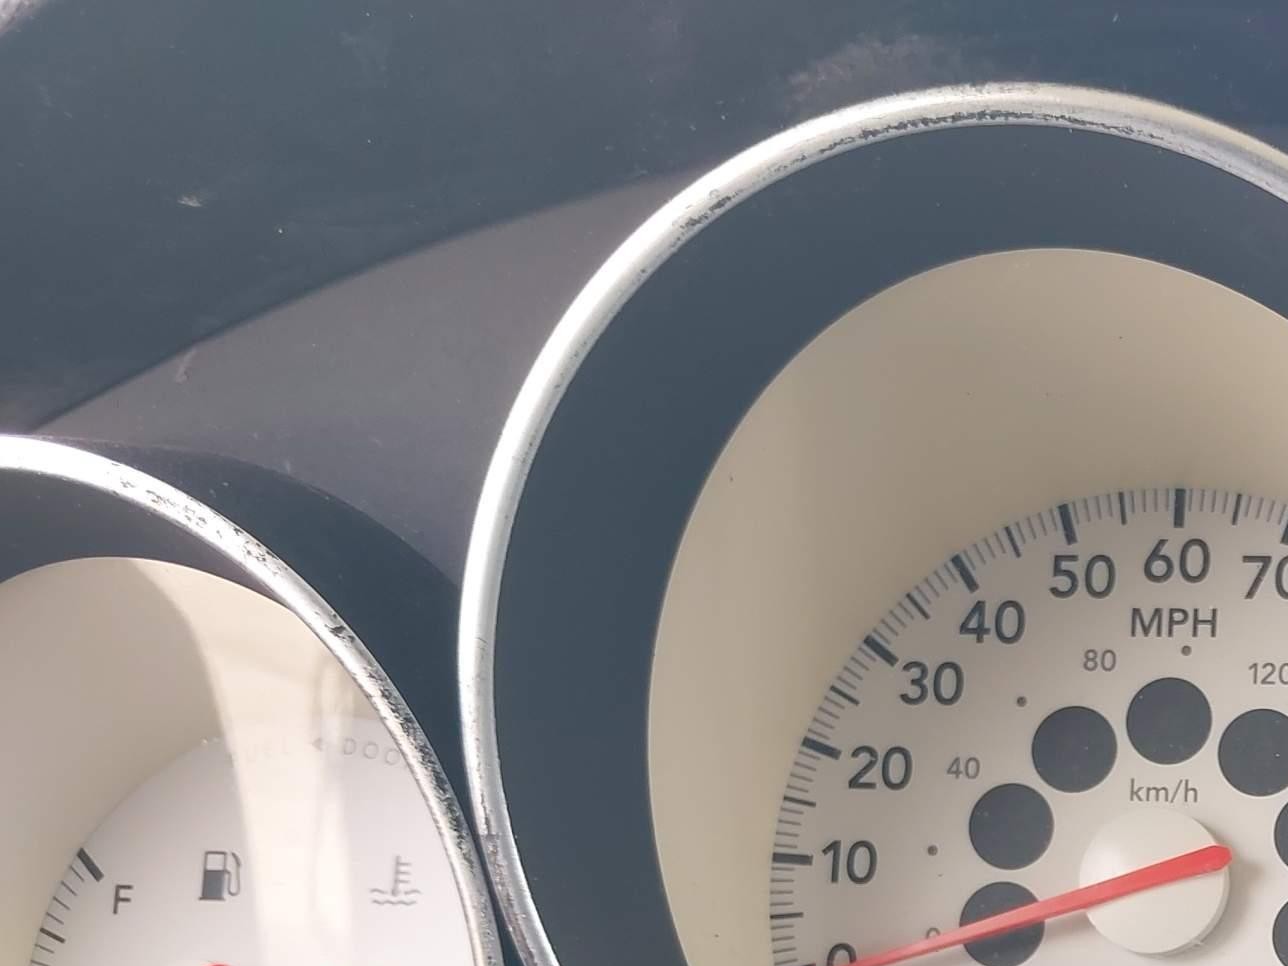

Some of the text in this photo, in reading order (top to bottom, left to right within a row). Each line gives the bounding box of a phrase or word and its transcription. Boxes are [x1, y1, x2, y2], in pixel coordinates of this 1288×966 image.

[1050, 555, 1115, 598] 50
[1144, 539, 1209, 583] 60
[960, 600, 1024, 644] 40
[1131, 608, 1216, 637] MPH
[1083, 649, 1116, 671] 80
[900, 661, 963, 705] 30
[342, 736, 408, 768] DOO
[849, 746, 911, 790] 20
[947, 757, 980, 778] 40
[1130, 778, 1197, 803] km/h
[822, 840, 876, 884] 10
[113, 885, 132, 914] F
